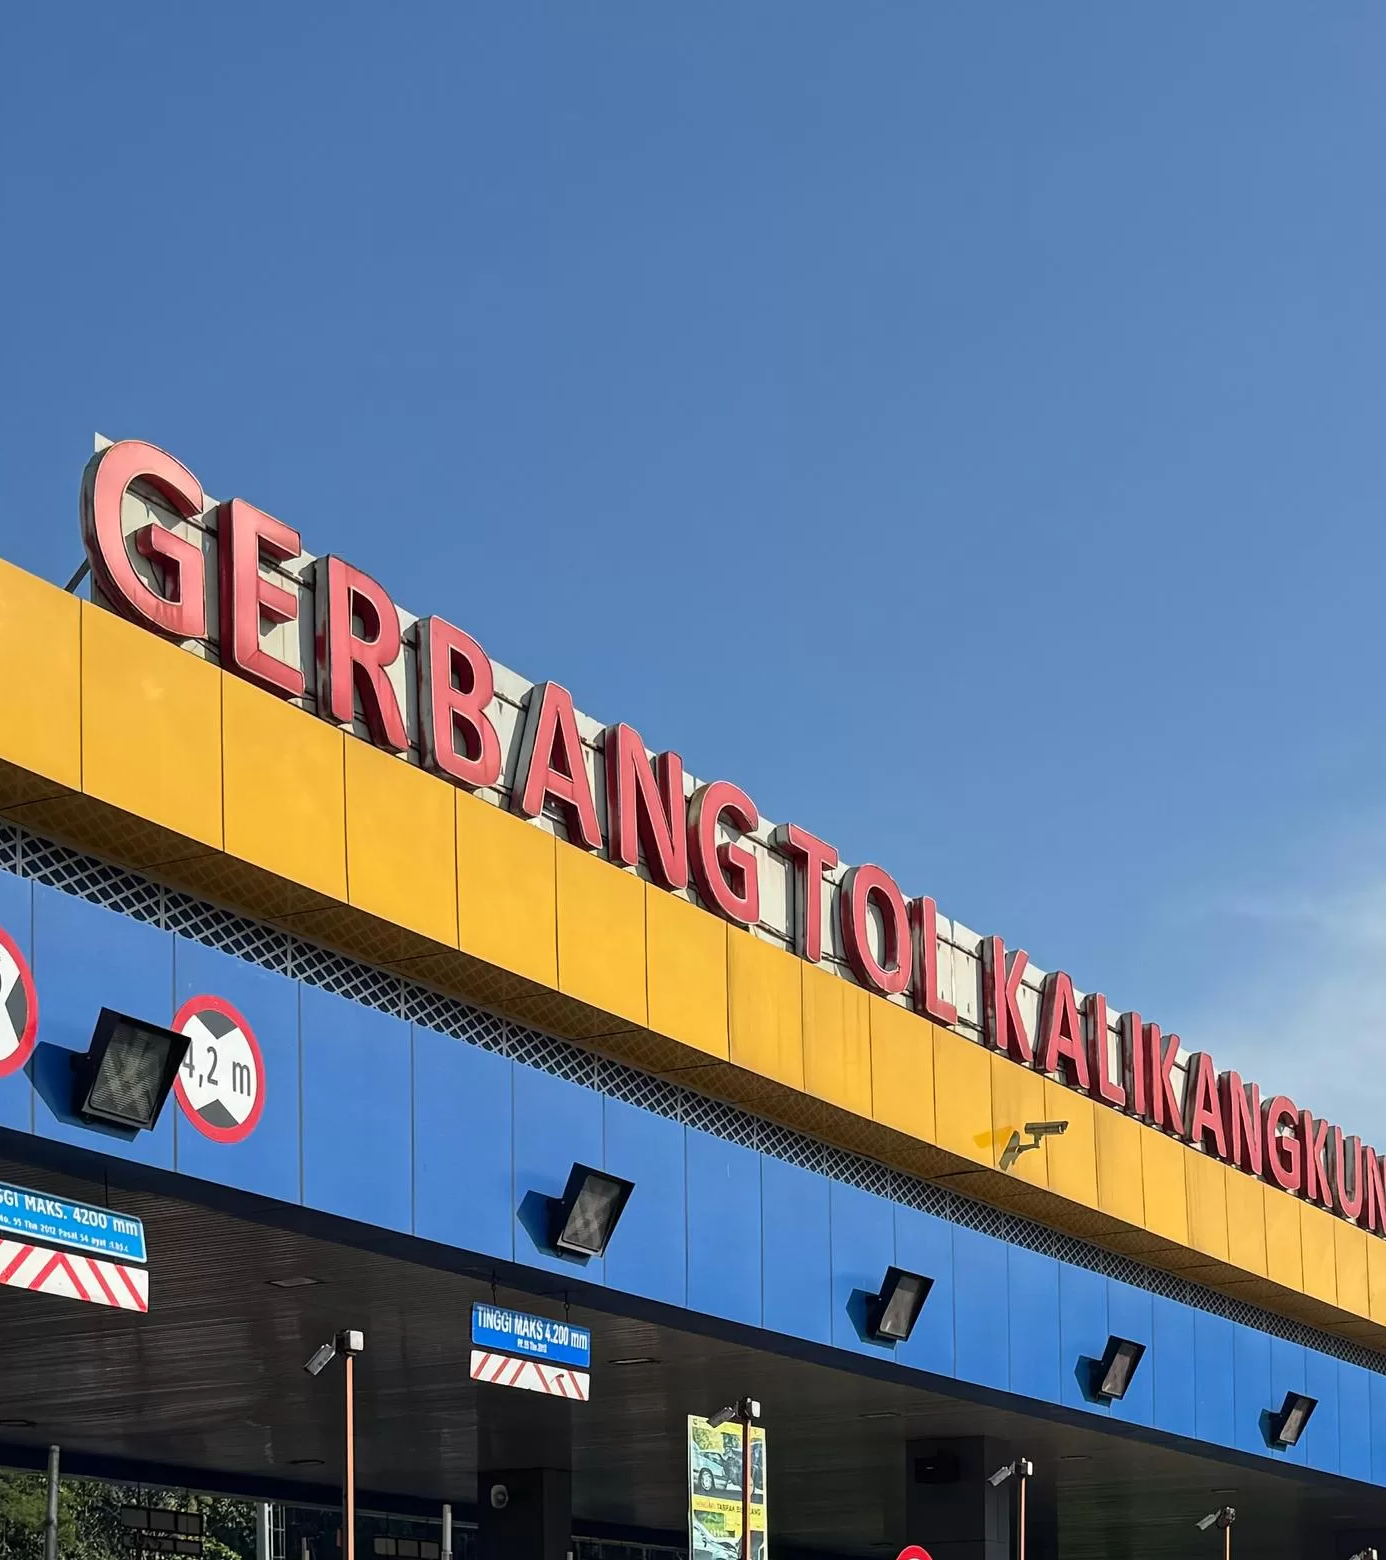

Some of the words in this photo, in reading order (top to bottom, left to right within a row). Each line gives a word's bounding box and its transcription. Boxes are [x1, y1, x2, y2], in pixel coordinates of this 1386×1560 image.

[81, 439, 762, 925] GERBANG
[775, 822, 958, 1026] TOL
[232, 1060, 251, 1097] m
[24, 1194, 67, 1220] MAKS.
[73, 1207, 107, 1229] 4200
[113, 1219, 139, 1237] mm
[477, 1306, 512, 1333] TINGGI
[514, 1315, 543, 1341] MAKS
[545, 1323, 569, 1346] 4.200
[571, 1332, 588, 1350] mm
